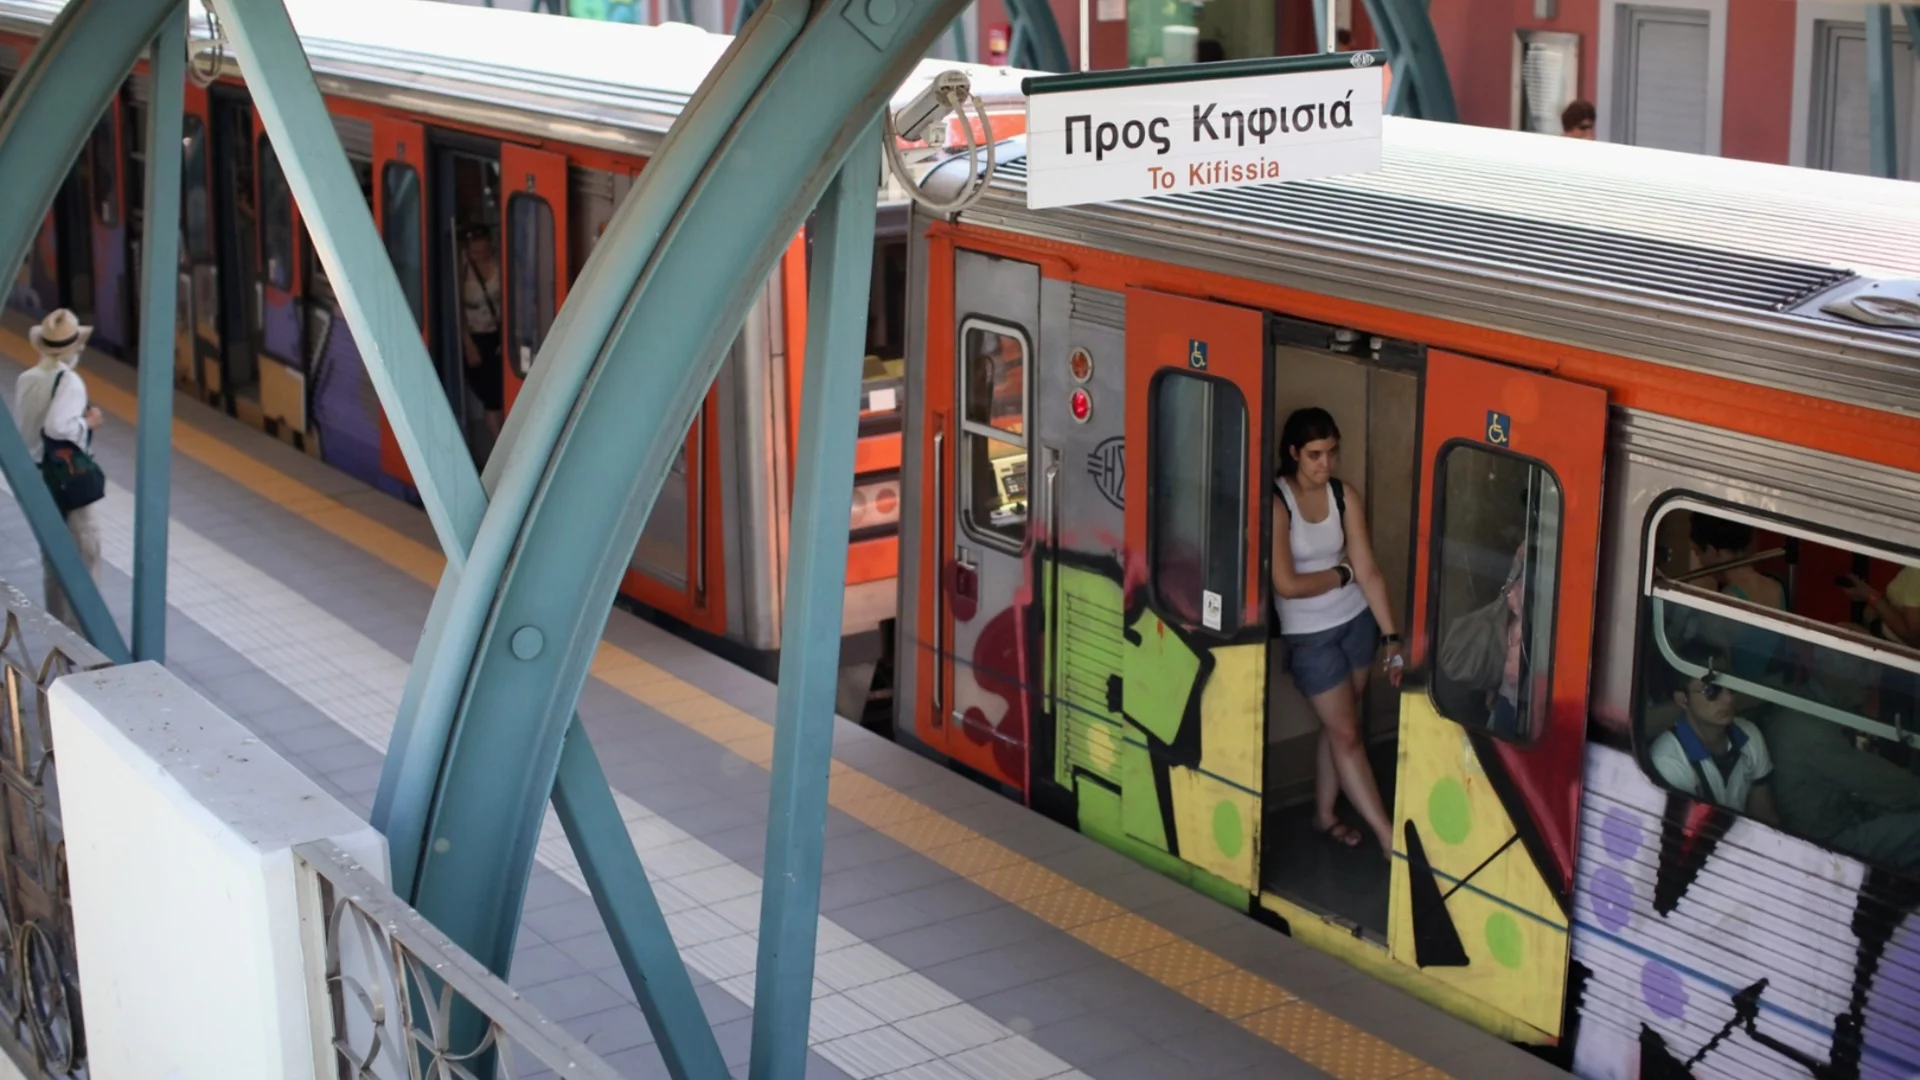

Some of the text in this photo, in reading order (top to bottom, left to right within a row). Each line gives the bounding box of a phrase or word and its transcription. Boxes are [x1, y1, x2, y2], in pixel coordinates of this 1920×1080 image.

[1065, 89, 1354, 161] Προς Κηφισιά
[1147, 157, 1280, 190] To Kifissia
